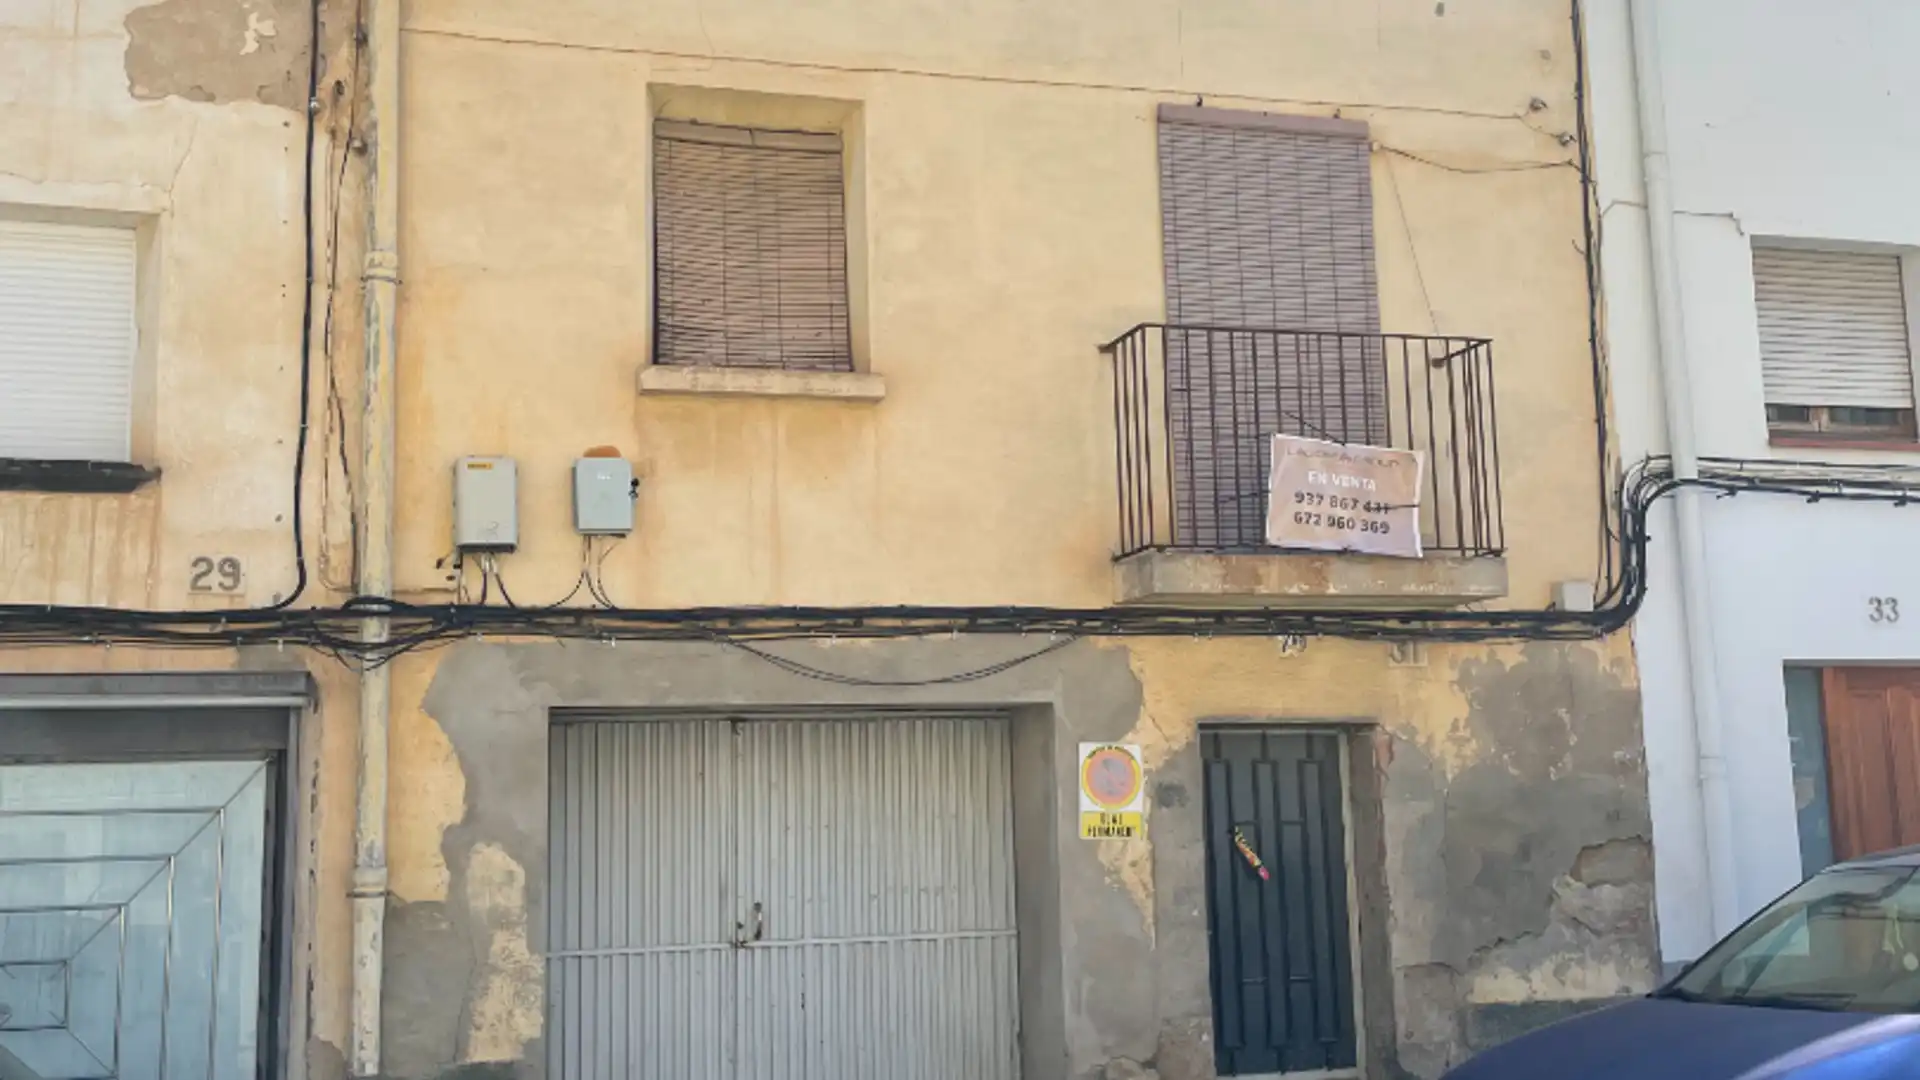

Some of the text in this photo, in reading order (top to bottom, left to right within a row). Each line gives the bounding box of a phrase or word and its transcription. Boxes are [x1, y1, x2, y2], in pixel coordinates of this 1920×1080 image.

[1308, 471, 1376, 492] EN VENTA
[1294, 490, 1324, 506] 937
[1329, 495, 1360, 511] 867
[1294, 511, 1390, 534] 672 960 369
[190, 556, 241, 591] 29
[1868, 596, 1900, 623] 33
